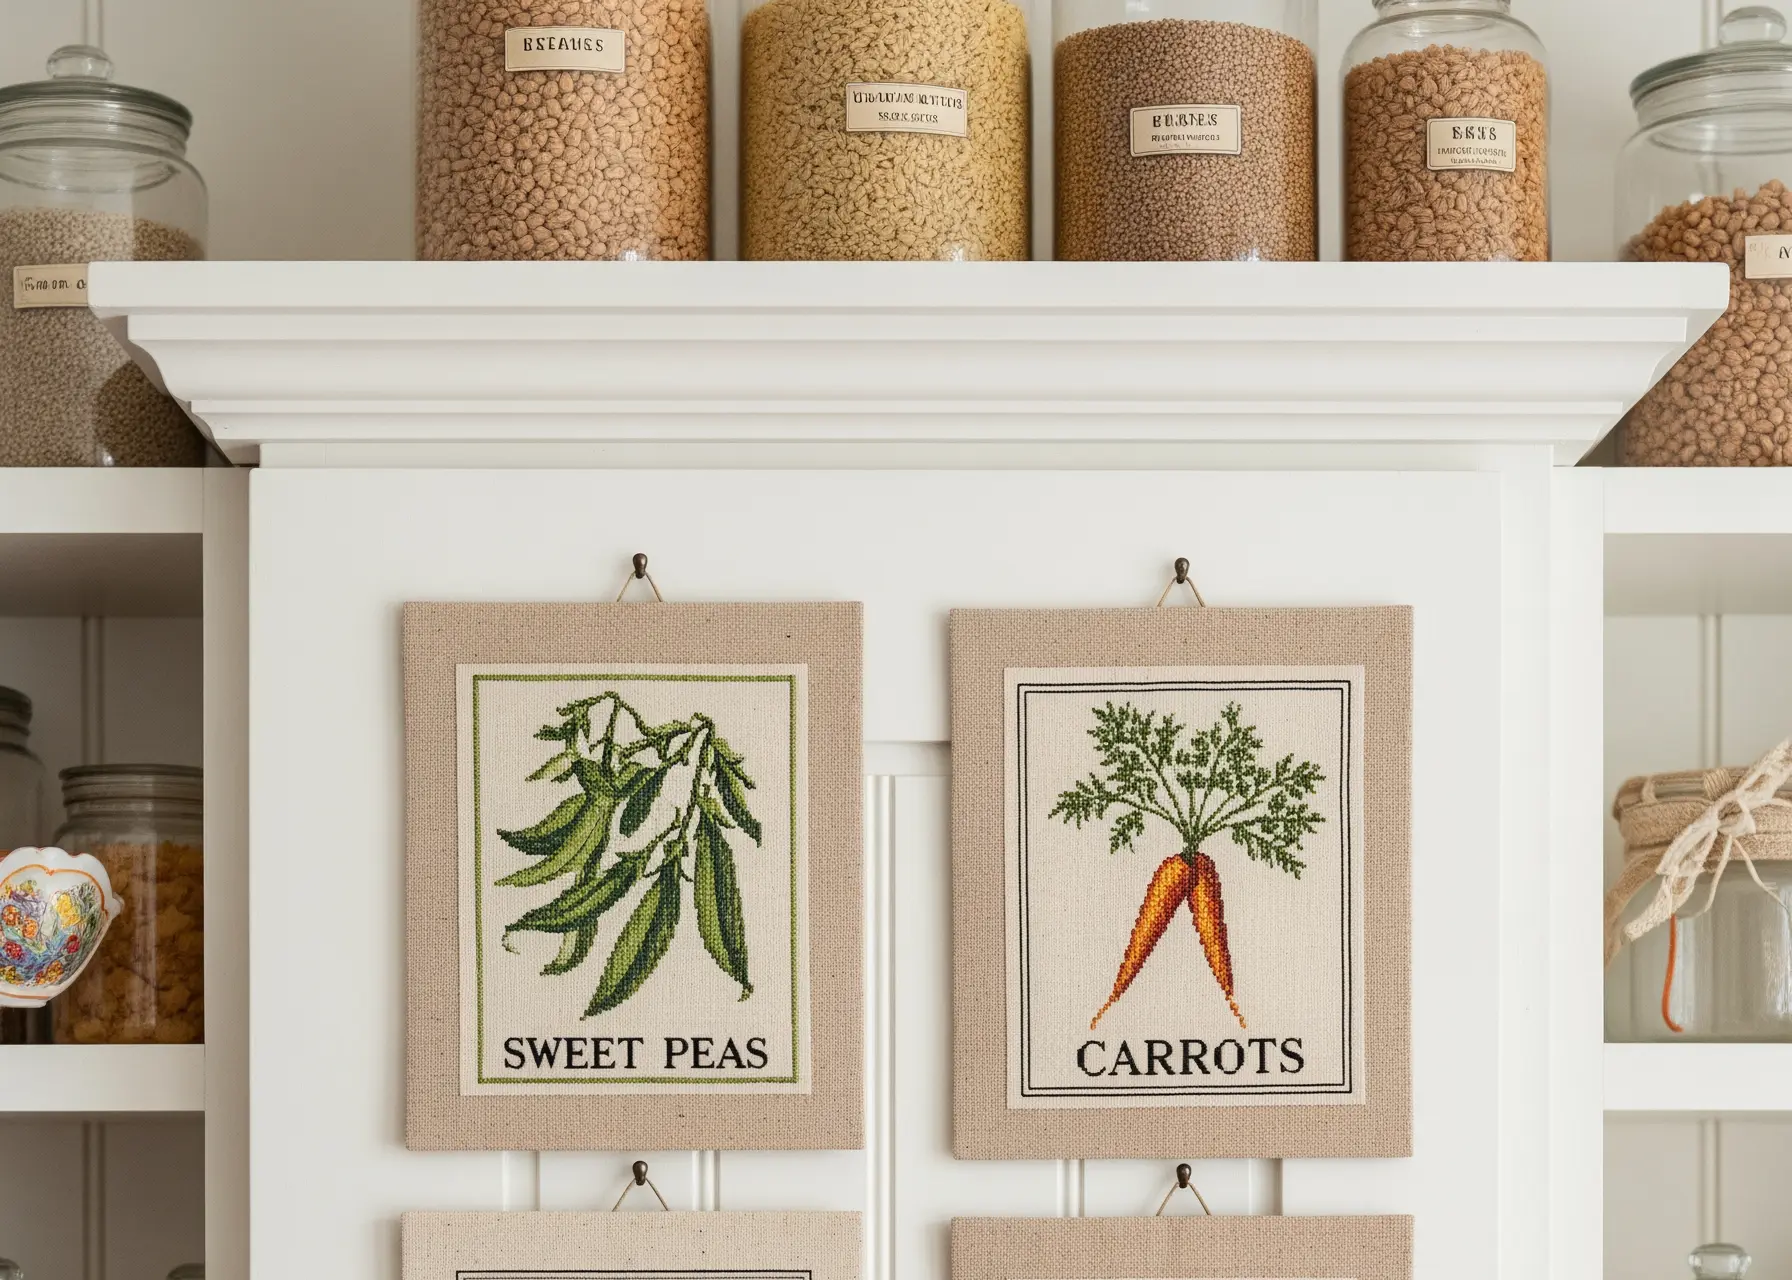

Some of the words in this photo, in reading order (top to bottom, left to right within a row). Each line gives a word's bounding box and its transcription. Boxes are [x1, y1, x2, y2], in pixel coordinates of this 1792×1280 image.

[503, 1036, 644, 1070] SWEET
[662, 1036, 768, 1070] PEAS
[1076, 1037, 1305, 1078] CARROTS
